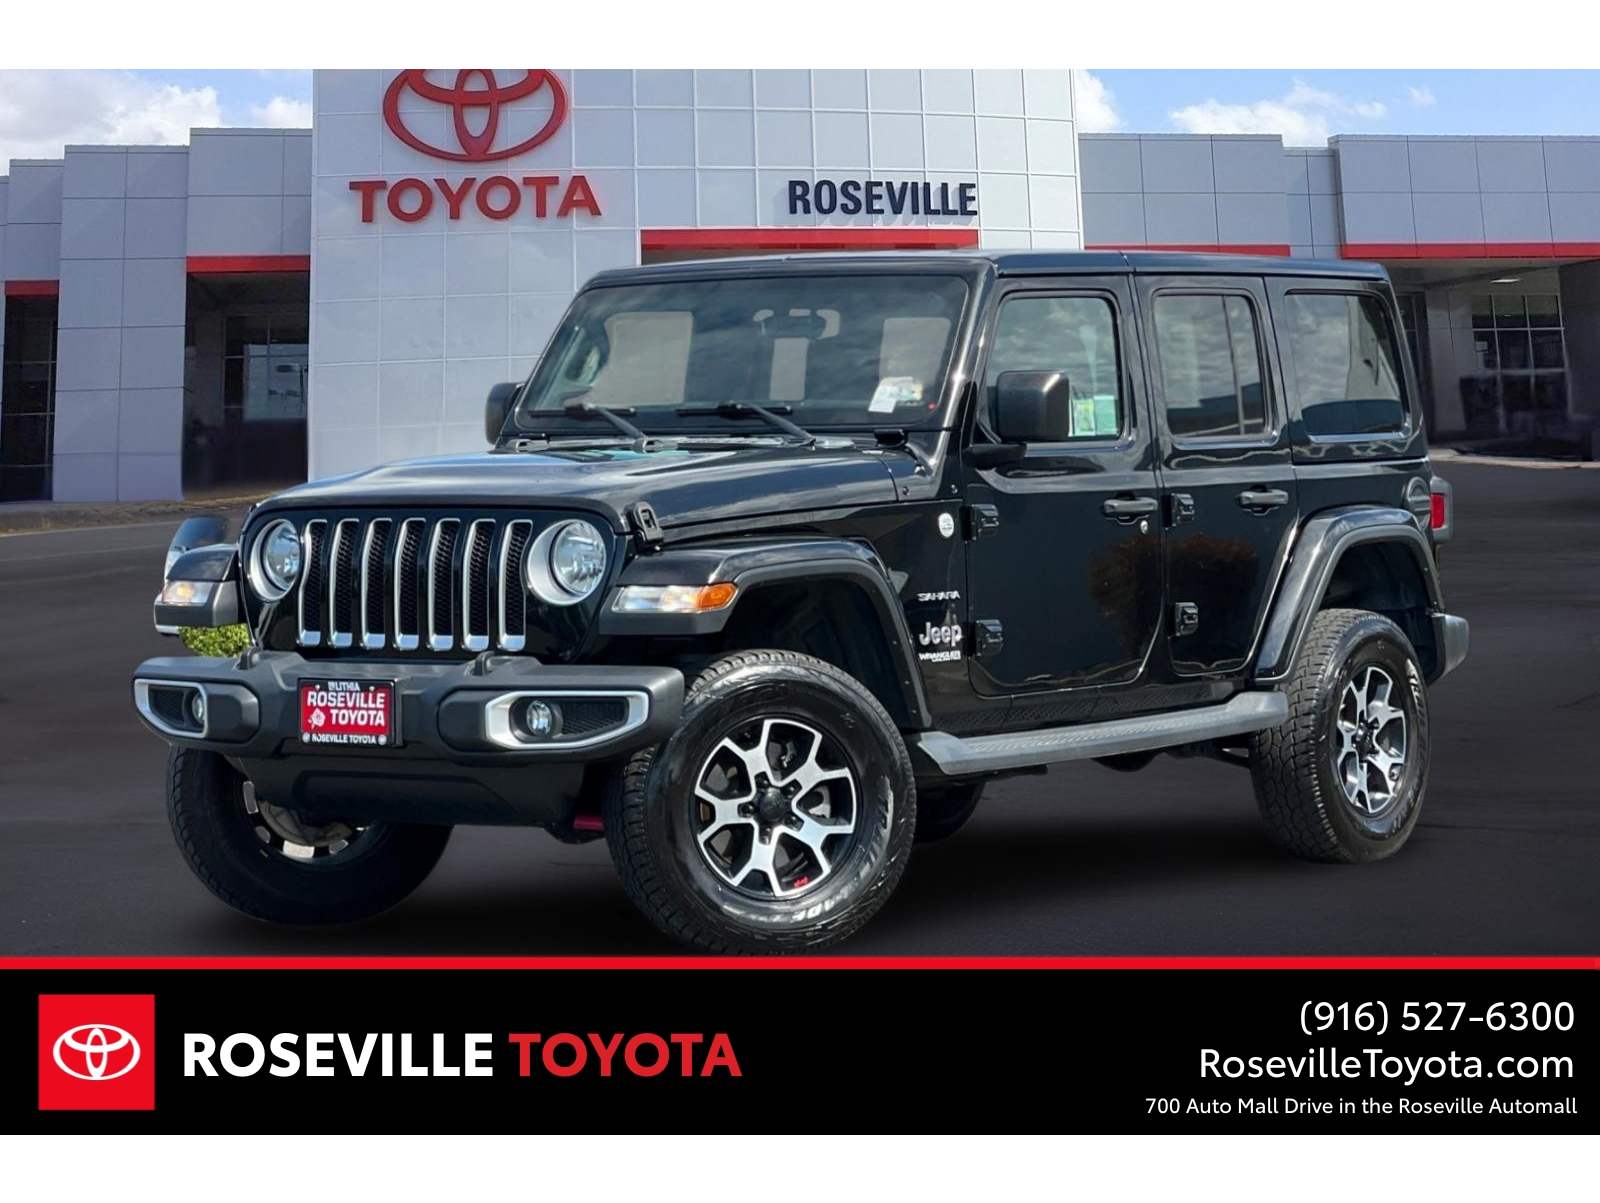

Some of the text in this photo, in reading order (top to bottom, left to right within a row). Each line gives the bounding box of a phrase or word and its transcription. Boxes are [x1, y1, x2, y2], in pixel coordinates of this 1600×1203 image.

[348, 175, 602, 224] TOYOTA
[788, 179, 978, 217] ROSEVILLE
[917, 590, 961, 602] SAHARA
[918, 621, 963, 647] Jeep
[306, 690, 386, 709] ROSEVILLE
[329, 708, 385, 726] TOYOTA
